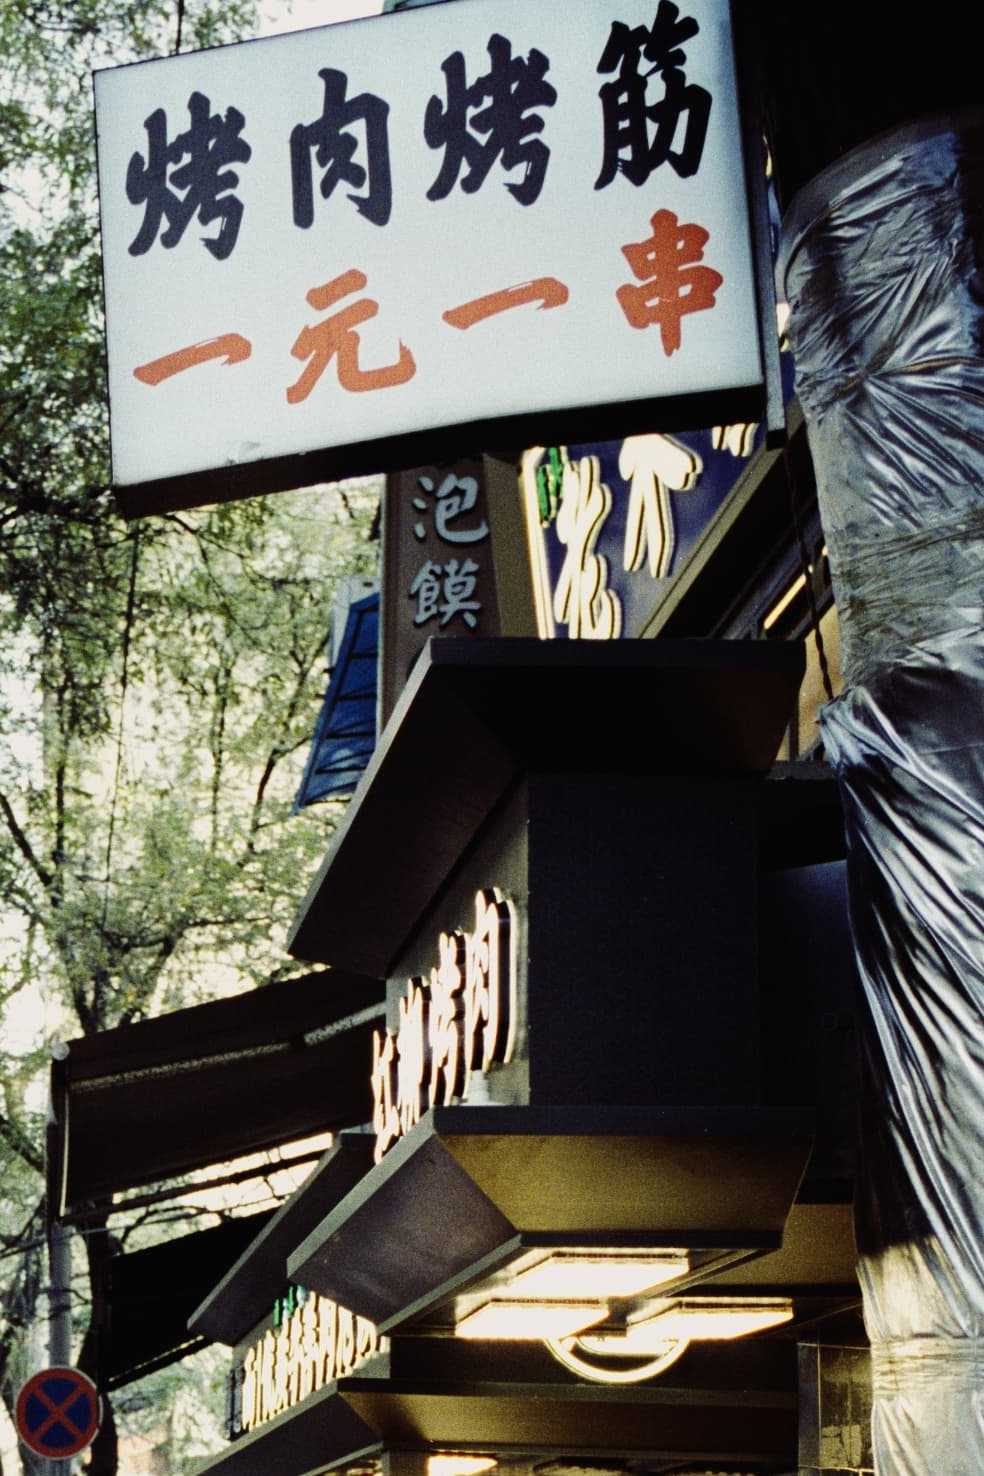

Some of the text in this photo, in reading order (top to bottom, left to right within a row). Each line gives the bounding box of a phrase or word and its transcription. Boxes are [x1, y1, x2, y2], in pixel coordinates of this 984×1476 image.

[126, 0, 713, 260] 烤肉烤筋
[133, 209, 724, 404] 一元一串
